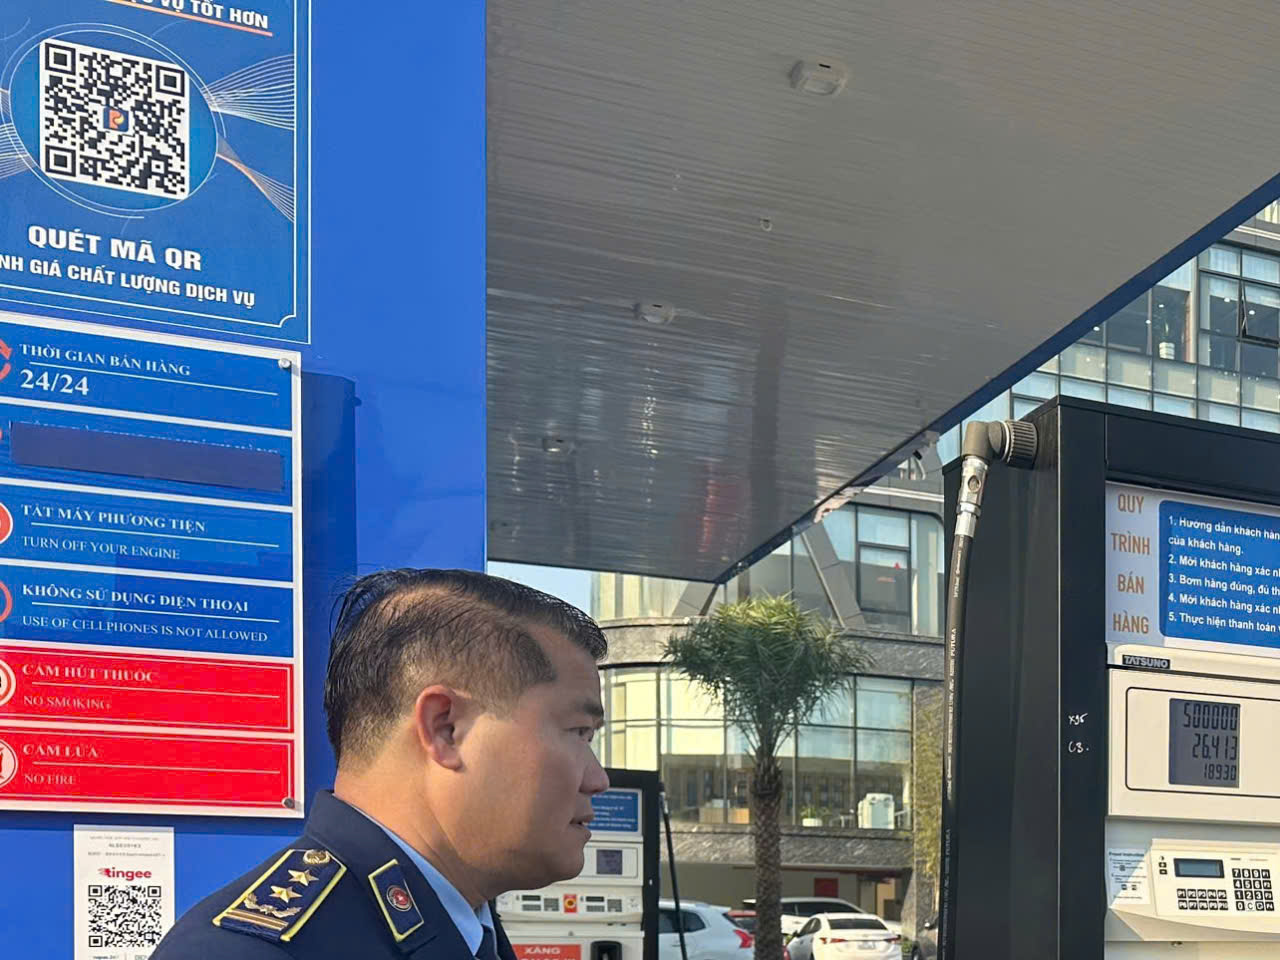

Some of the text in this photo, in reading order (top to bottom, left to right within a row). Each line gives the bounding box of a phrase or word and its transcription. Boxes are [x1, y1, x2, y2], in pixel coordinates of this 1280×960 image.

[230, 8, 268, 28] HƠN
[28, 225, 202, 271] QUÉT MÃ QR
[30, 258, 62, 278] GIÁ
[68, 264, 115, 285] CHẤT
[120, 272, 180, 296] LƯỢNG
[186, 283, 228, 302] DỊCH
[232, 290, 256, 309] VỤ
[20, 344, 190, 376] THỜI GIAN BÁN HÀNG
[20, 369, 89, 396] 24/24
[1118, 493, 1144, 514] QUY
[58, 506, 94, 521] MÁY
[98, 512, 165, 528] PHƯƠNG
[168, 518, 206, 533] TIỆN
[1169, 516, 1176, 525] 1.
[1234, 524, 1261, 537] khách
[22, 536, 180, 560] TURN OFF YOUR ENGINE
[1111, 531, 1150, 556] TRÌNH
[1168, 535, 1244, 555] của khách hàng.
[1168, 554, 1176, 564] 2.
[1180, 555, 1197, 566] Mời
[1200, 558, 1227, 570] khách
[1230, 562, 1252, 576] hàng
[1255, 566, 1270, 576] xác
[1118, 570, 1144, 594] BÁN
[1168, 574, 1176, 583] 3.
[1180, 575, 1202, 586] Bơm
[1204, 578, 1227, 591] hàng
[23, 584, 82, 599] KHÔNG
[112, 592, 156, 606] DỤNG
[160, 595, 196, 609] ĐIỆN
[200, 598, 248, 614] THOẠI
[1168, 593, 1176, 602] 4.
[1180, 594, 1197, 604] Mời
[1200, 596, 1227, 608] khách
[1230, 600, 1252, 613] hàng
[1255, 603, 1270, 613] xác
[23, 616, 268, 642] USE OF CELLPHONES IS NOT ALLOWED
[1113, 610, 1149, 634] HÀNG
[1168, 612, 1176, 622] 5.
[1180, 612, 1204, 626] Thực
[1206, 616, 1226, 628] hiện
[1228, 619, 1254, 630] thanh
[1257, 622, 1276, 632] toán
[1124, 656, 1168, 668] TATSUNO
[24, 696, 110, 709] NO SMOKING
[1183, 702, 1238, 730] 500000
[24, 775, 74, 784] NO FIRE
[1204, 763, 1236, 780] 18930
[105, 867, 152, 881] tingee
